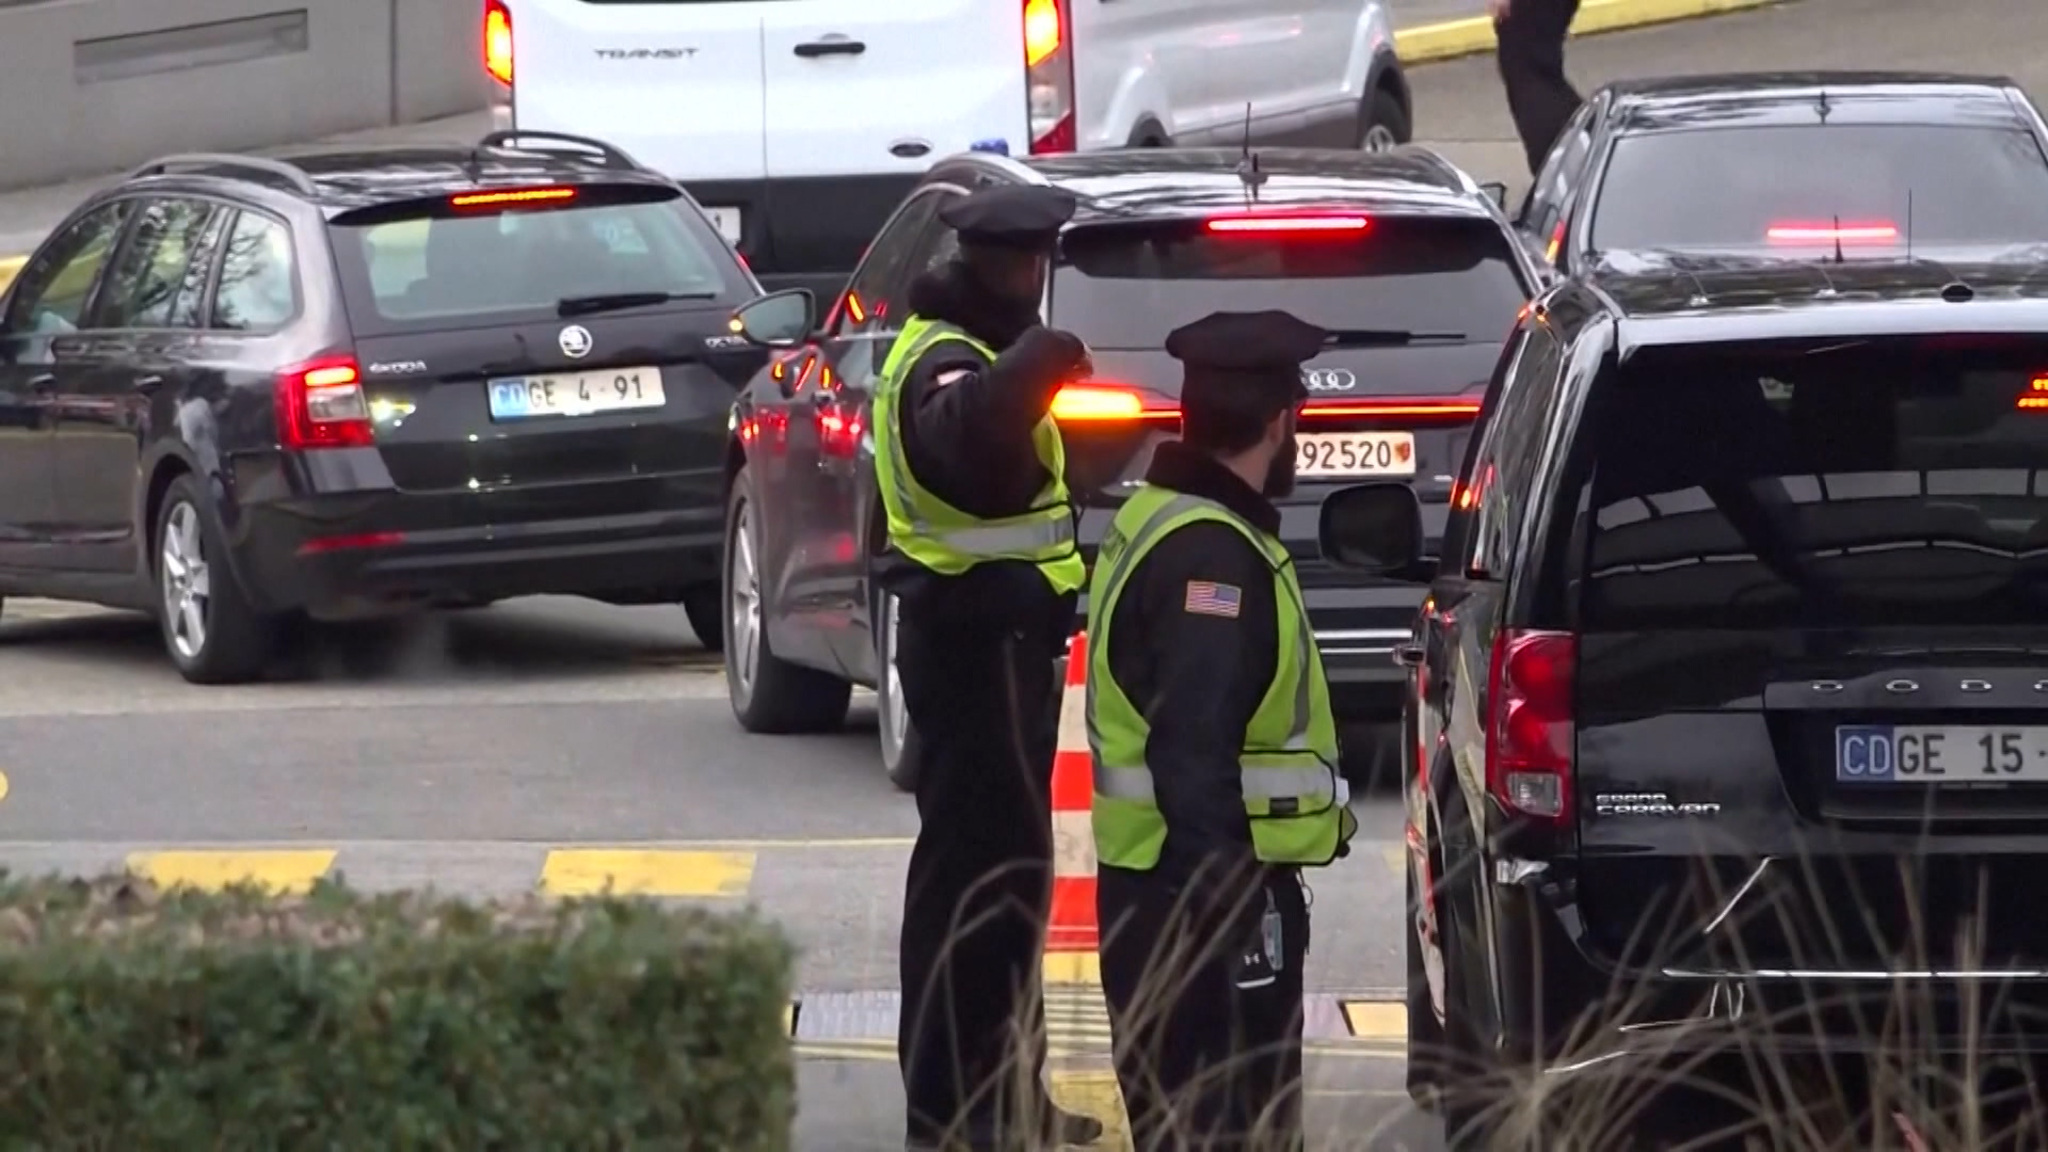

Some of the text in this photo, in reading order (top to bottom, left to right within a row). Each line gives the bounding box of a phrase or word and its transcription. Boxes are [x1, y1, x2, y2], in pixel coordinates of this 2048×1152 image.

[593, 47, 700, 60] TRANSIT
[529, 380, 556, 408] GE
[1296, 440, 1391, 469] 92520
[1843, 735, 1891, 775] CD
[1898, 734, 1946, 775] GE
